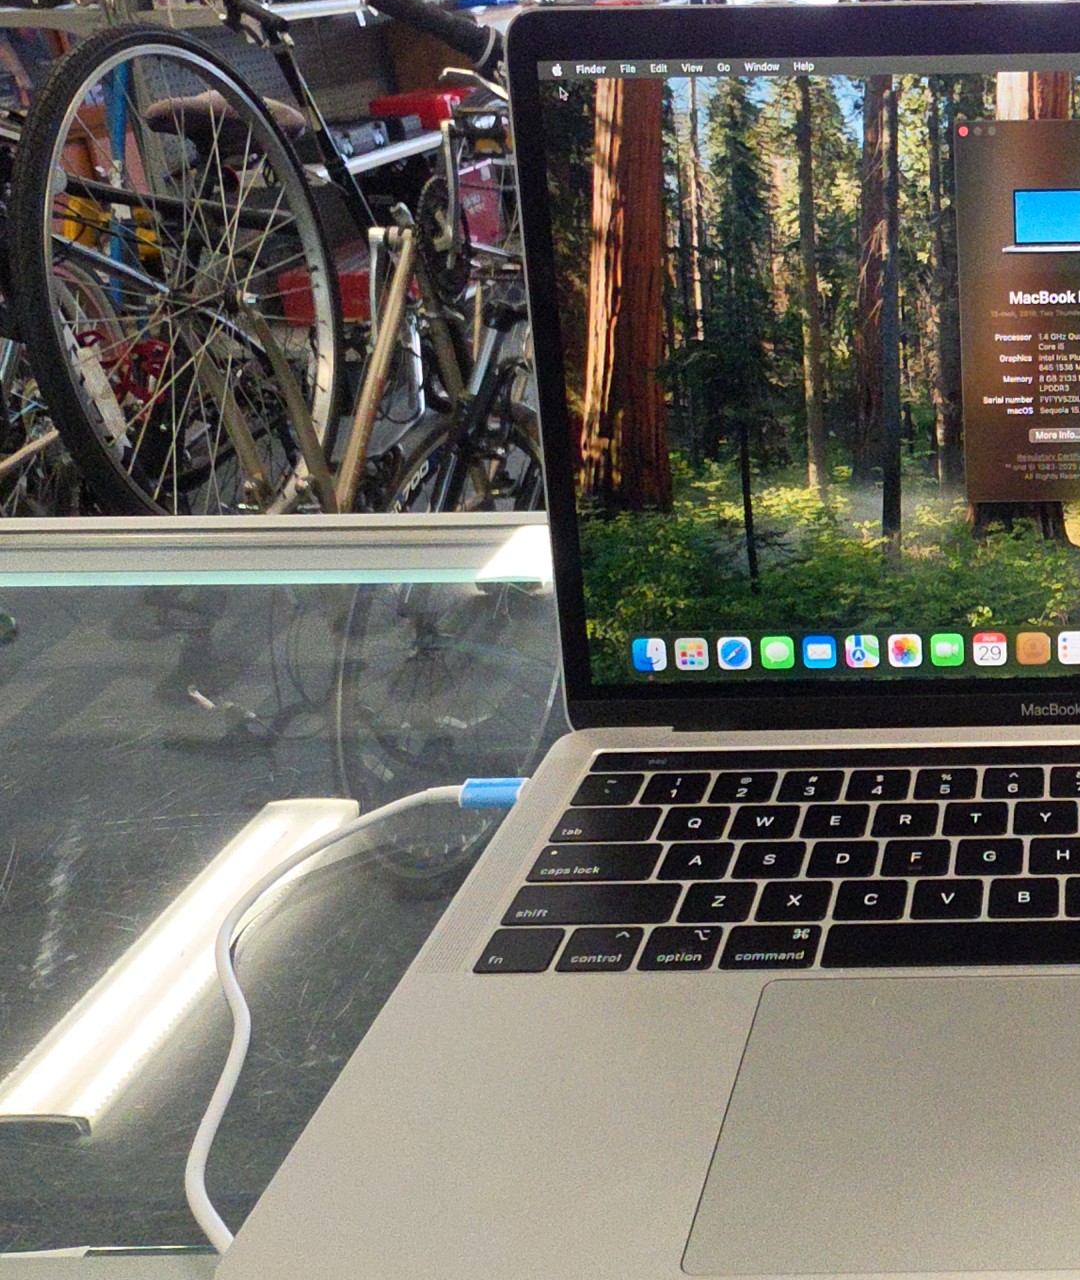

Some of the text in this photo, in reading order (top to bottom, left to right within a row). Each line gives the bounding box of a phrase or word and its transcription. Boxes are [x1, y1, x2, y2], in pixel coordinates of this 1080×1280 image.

[576, 60, 815, 75] Finder File Edit View Go Window Help
[1009, 290, 1076, 305] MacBook
[1038, 343, 1056, 351] Core
[999, 355, 1032, 363] Graphics
[1003, 376, 1033, 384] Memory
[983, 396, 1004, 404] Serial
[1005, 396, 1033, 404] number
[1040, 407, 1069, 415] Sequoia
[1035, 431, 1057, 440] More
[402, 460, 429, 501] 700
[978, 645, 1002, 662] 29
[736, 788, 747, 797] 2
[804, 787, 815, 795] 3
[872, 786, 882, 794] 4
[940, 785, 950, 793] 5
[1008, 784, 1018, 792] 6
[671, 789, 677, 797] 1
[757, 817, 774, 826] W
[830, 816, 841, 825] E
[900, 815, 911, 824] R
[971, 813, 981, 823] T
[1040, 813, 1051, 822] Y
[688, 818, 701, 828] Q
[763, 854, 776, 864] S
[836, 853, 849, 863] D
[911, 852, 921, 862] F
[983, 851, 996, 861] G
[1057, 850, 1069, 860] H
[689, 855, 701, 865] A
[540, 866, 599, 876] caps lock
[787, 895, 802, 906] X
[864, 894, 878, 905] C
[941, 893, 954, 904] V
[1018, 891, 1030, 902] B
[712, 896, 726, 907] Z
[516, 909, 548, 918] shift
[488, 956, 503, 964] fn
[571, 954, 622, 963] control
[657, 953, 702, 963] option
[736, 951, 804, 960] command
